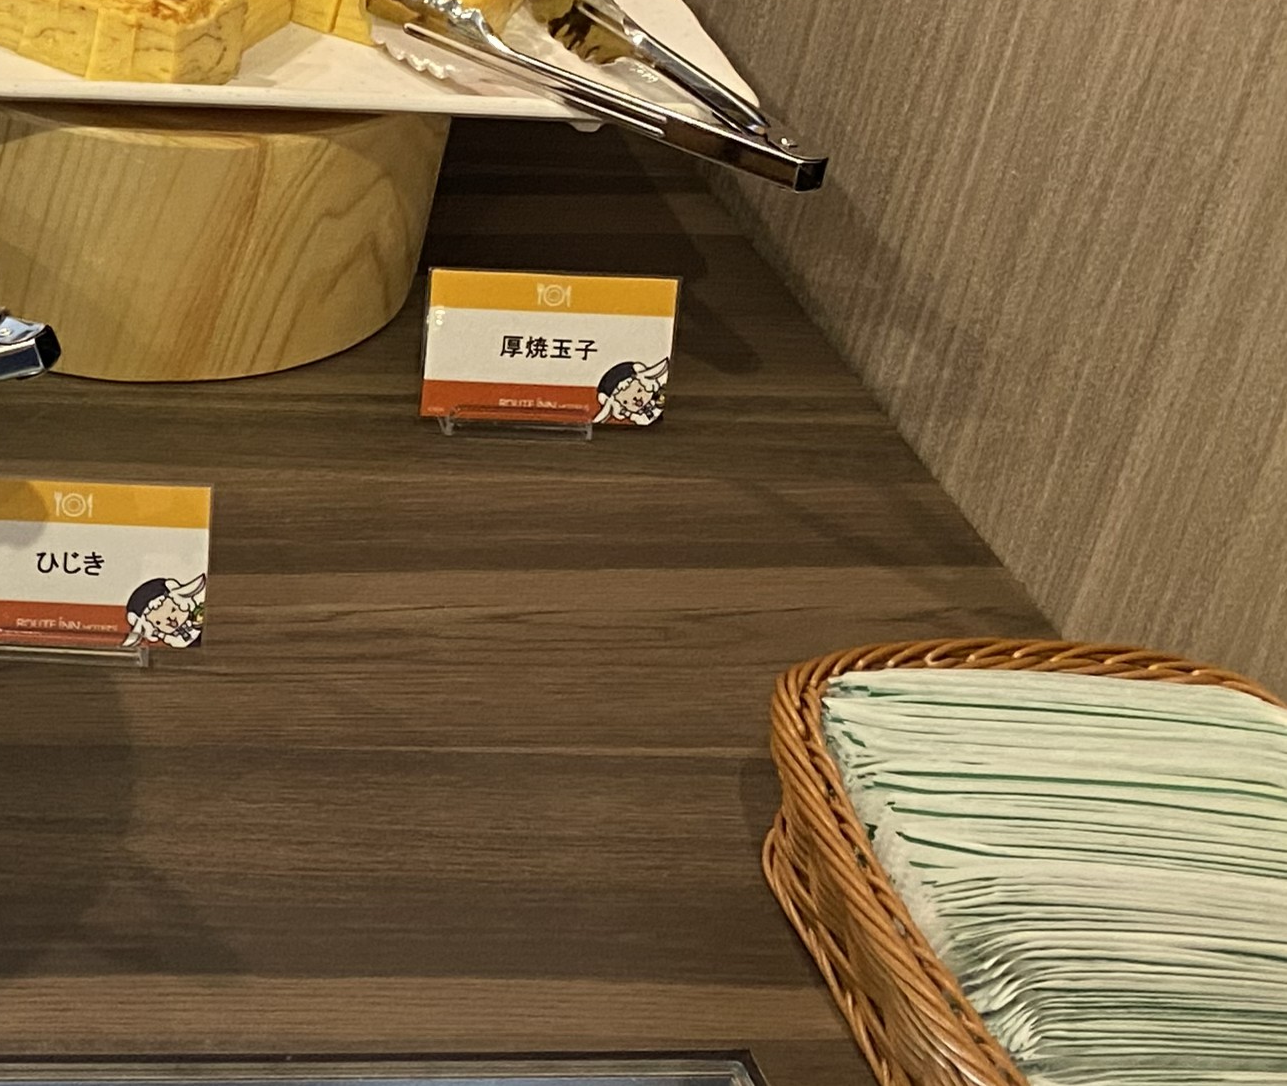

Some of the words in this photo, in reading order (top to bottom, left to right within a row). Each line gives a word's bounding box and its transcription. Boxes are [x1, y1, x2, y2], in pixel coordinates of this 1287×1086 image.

[499, 334, 599, 361] 厚焼玉子
[36, 551, 106, 577] ひじき
